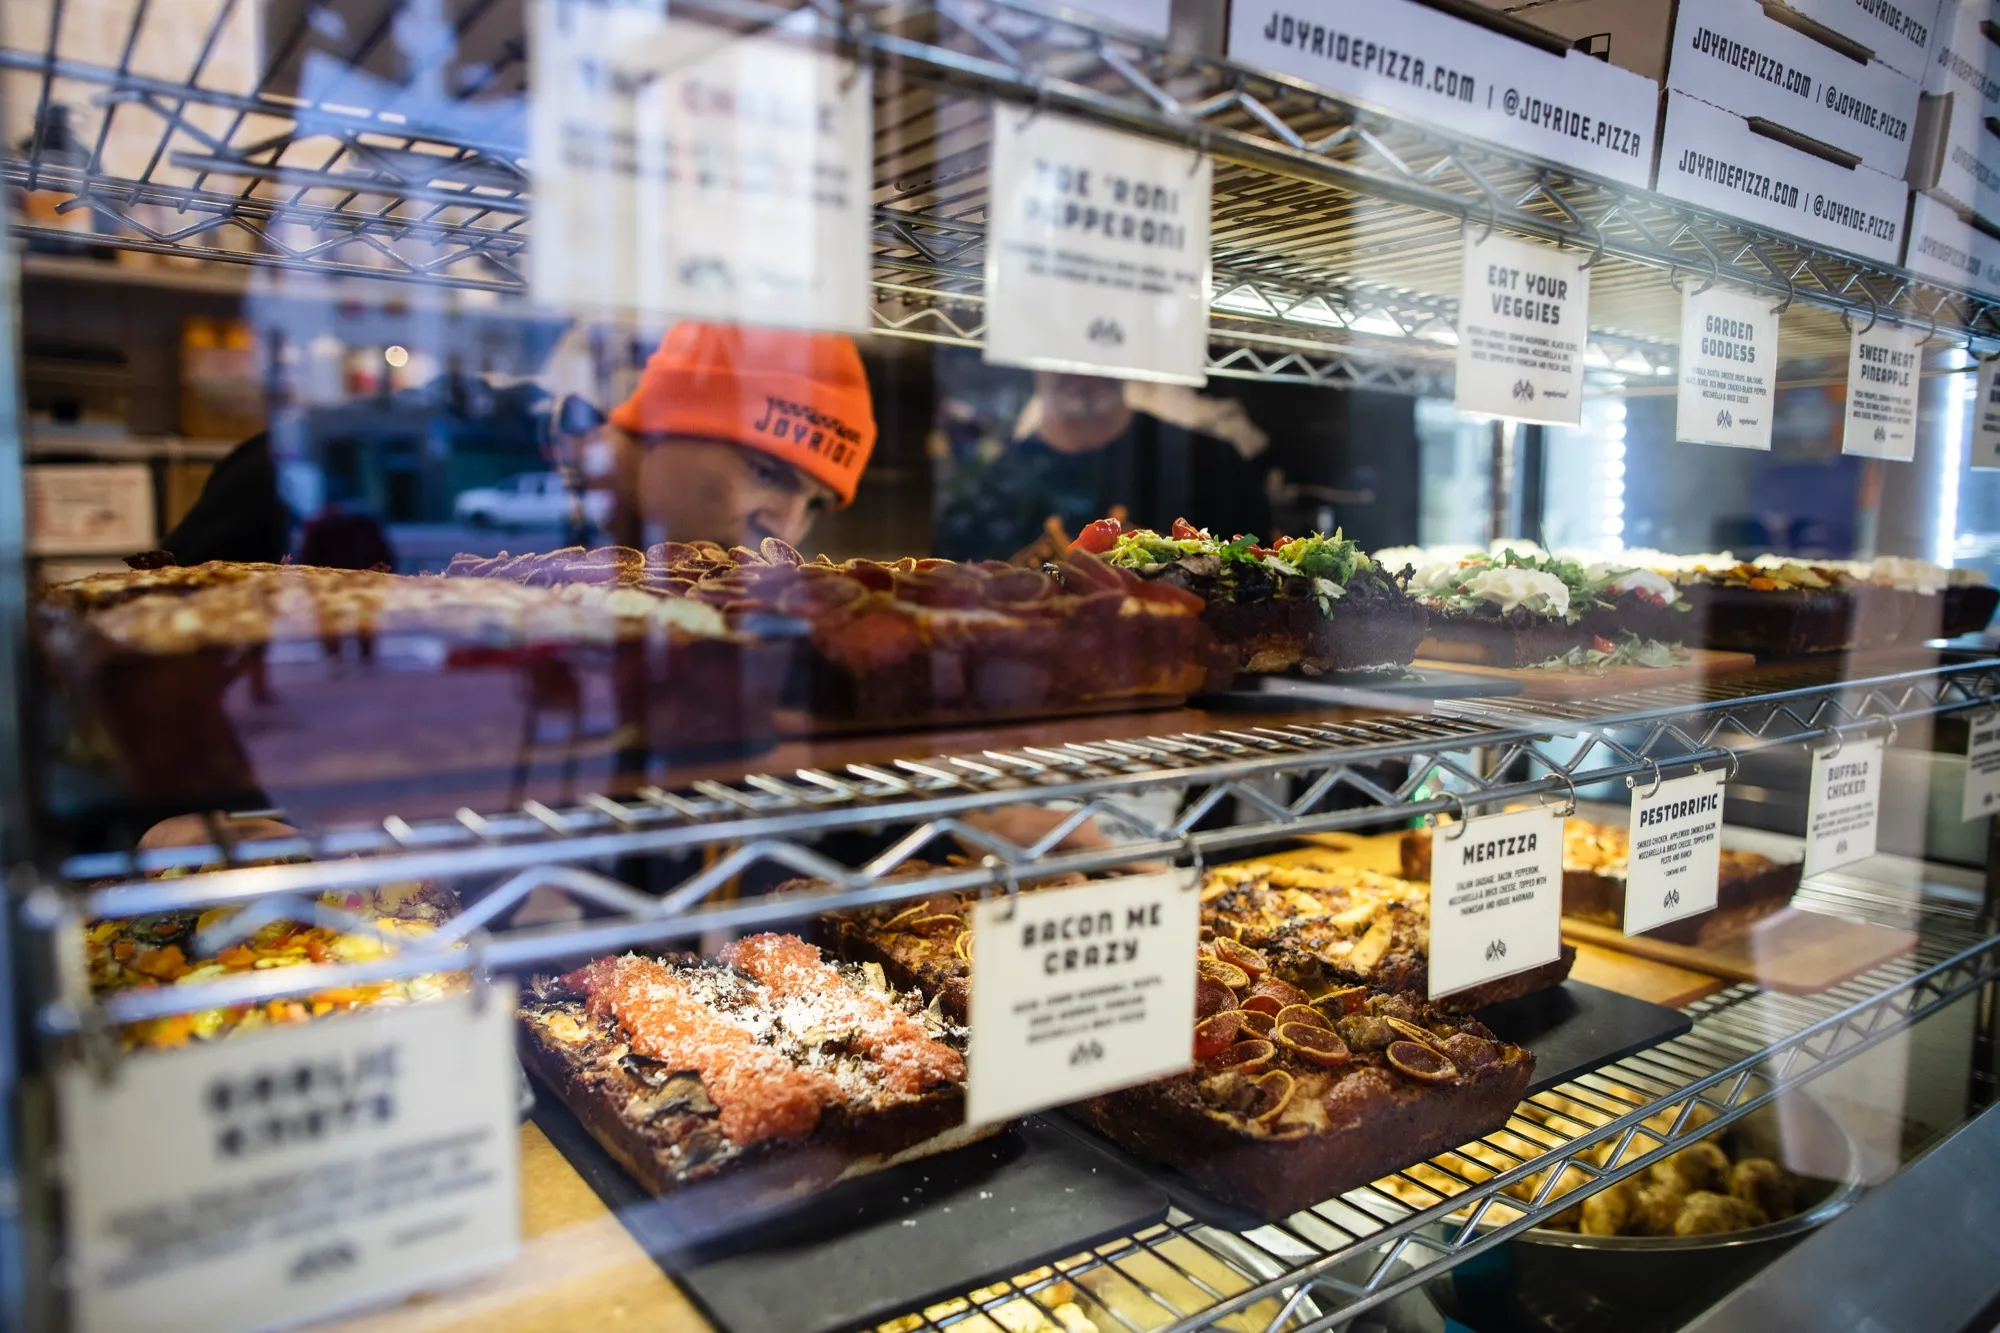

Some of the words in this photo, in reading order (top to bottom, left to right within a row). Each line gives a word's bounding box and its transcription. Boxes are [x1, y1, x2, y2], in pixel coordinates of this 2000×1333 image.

[1264, 12, 1475, 104] JOYRIDEPIZZA.COM
[1503, 88, 1642, 158] @JOYRIDE.PIZZA
[1692, 27, 1812, 98] JOYRIDEPIZZA.COM
[1825, 86, 1908, 142] @JOYRIDE.PIZZA
[1678, 149, 1799, 209] JOYRIDEPIZZA.COM
[1813, 194, 1896, 242] @JOYRIDE.PIZZA
[1024, 199, 1187, 250] PPPERONI
[1488, 265, 1520, 290] EAT
[1526, 273, 1567, 301] YOUR
[1492, 293, 1560, 325] VEGGIES
[1706, 315, 1753, 341] GARDEN
[1701, 337, 1755, 364] GODDESS
[1859, 344, 1889, 364] SWEET
[1891, 350, 1915, 368] HEAT
[1861, 364, 1910, 387] PINEAPPLE
[1828, 761, 1868, 782] BUFFALO
[1827, 779, 1866, 800] CHICKEN
[1640, 793, 1718, 828] PESTORRIFIC
[1463, 833, 1537, 865] MEATZZA
[1637, 839, 1651, 849] SMOKED
[1670, 829, 1690, 840] APPLEWOOD
[1691, 825, 1704, 835] SMOKED
[1638, 847, 1662, 860] MOZZARELLA
[1667, 843, 1677, 852] BRICK
[1661, 855, 1671, 865] PESTO
[1681, 850, 1692, 859] RANCH
[1519, 879, 1535, 888] TOPPED
[1536, 876, 1547, 885] WITH
[1022, 910, 1113, 948] BACON
[1127, 904, 1162, 928] ME
[1044, 939, 1139, 975] CRAZY
